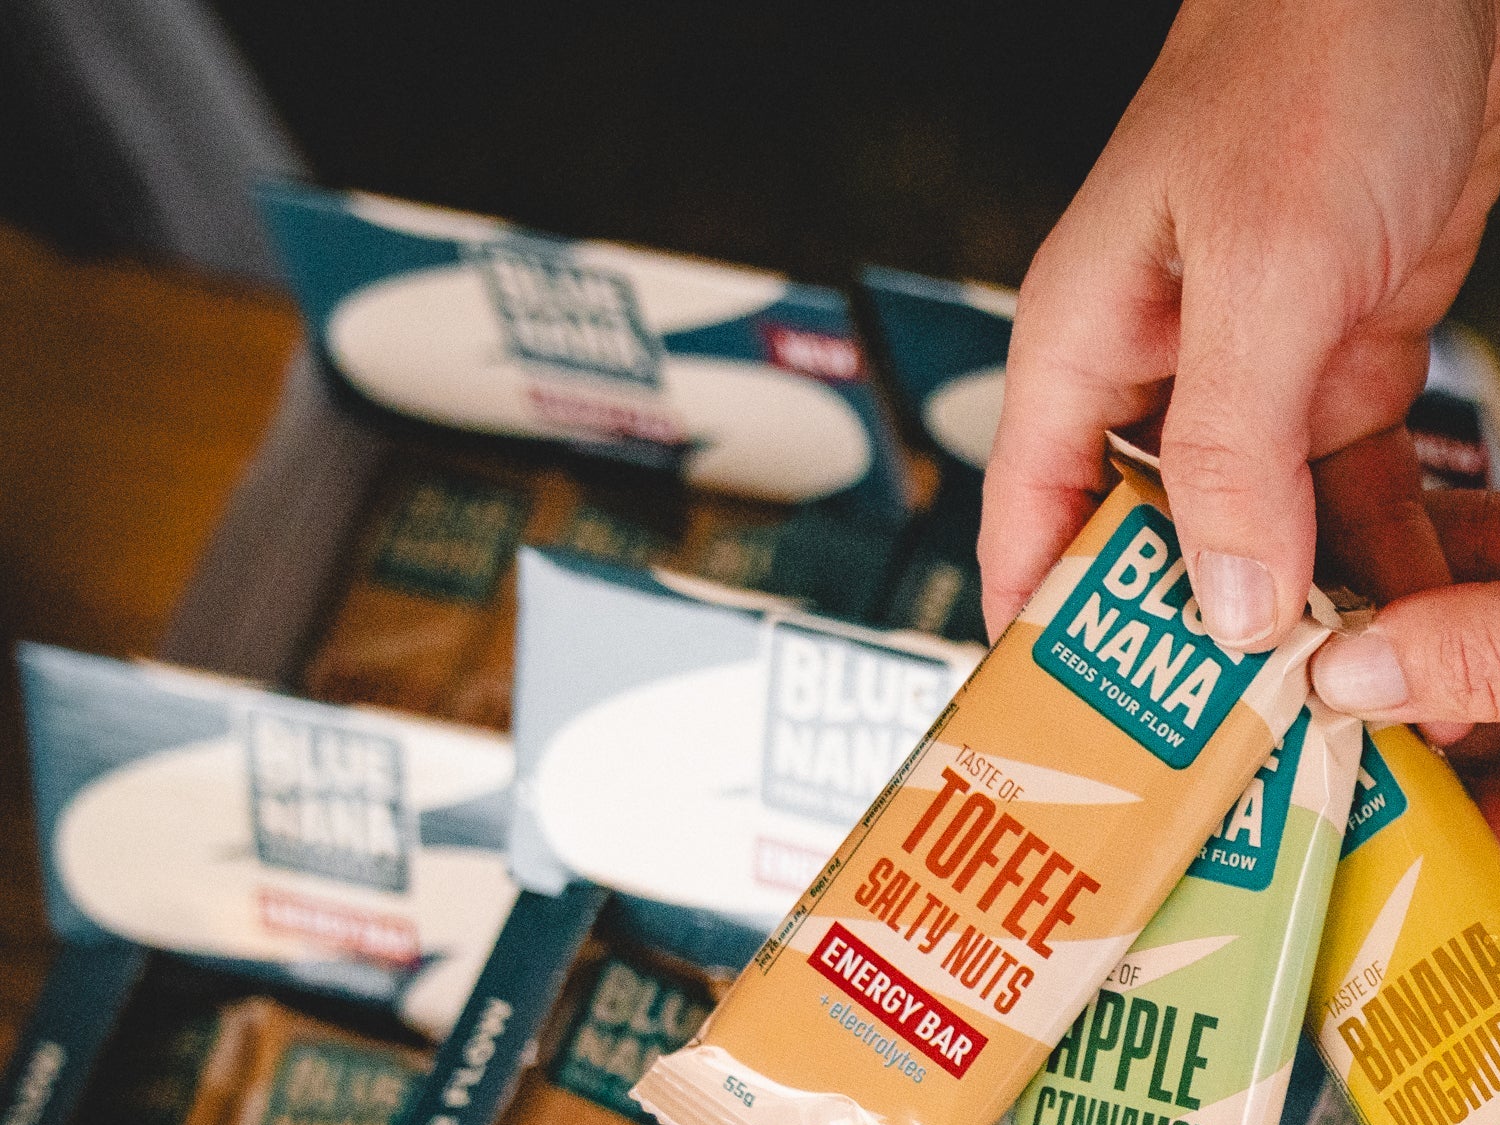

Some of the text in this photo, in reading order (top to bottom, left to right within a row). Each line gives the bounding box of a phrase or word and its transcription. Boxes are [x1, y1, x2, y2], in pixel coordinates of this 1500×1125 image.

[1103, 525, 1245, 666] BL
[1051, 641, 1185, 748] FEEDS YOUR FLOW
[1066, 591, 1222, 730] NANA
[954, 744, 1025, 804] TASTE OF
[1347, 792, 1387, 831] FLOW
[901, 765, 1102, 960] TOFFEE
[1211, 849, 1257, 872] FLOW
[854, 857, 960, 955] SALTY
[940, 924, 1036, 1016] NUTS
[1119, 963, 1142, 988] OF
[592, 961, 704, 1040] BLU
[820, 936, 973, 1067] ENERGY BAR
[1323, 960, 1384, 1018] TASTE OF
[829, 1003, 927, 1083] electrolytes
[1046, 988, 1219, 1112] APPLE
[722, 1075, 757, 1108] 55g
